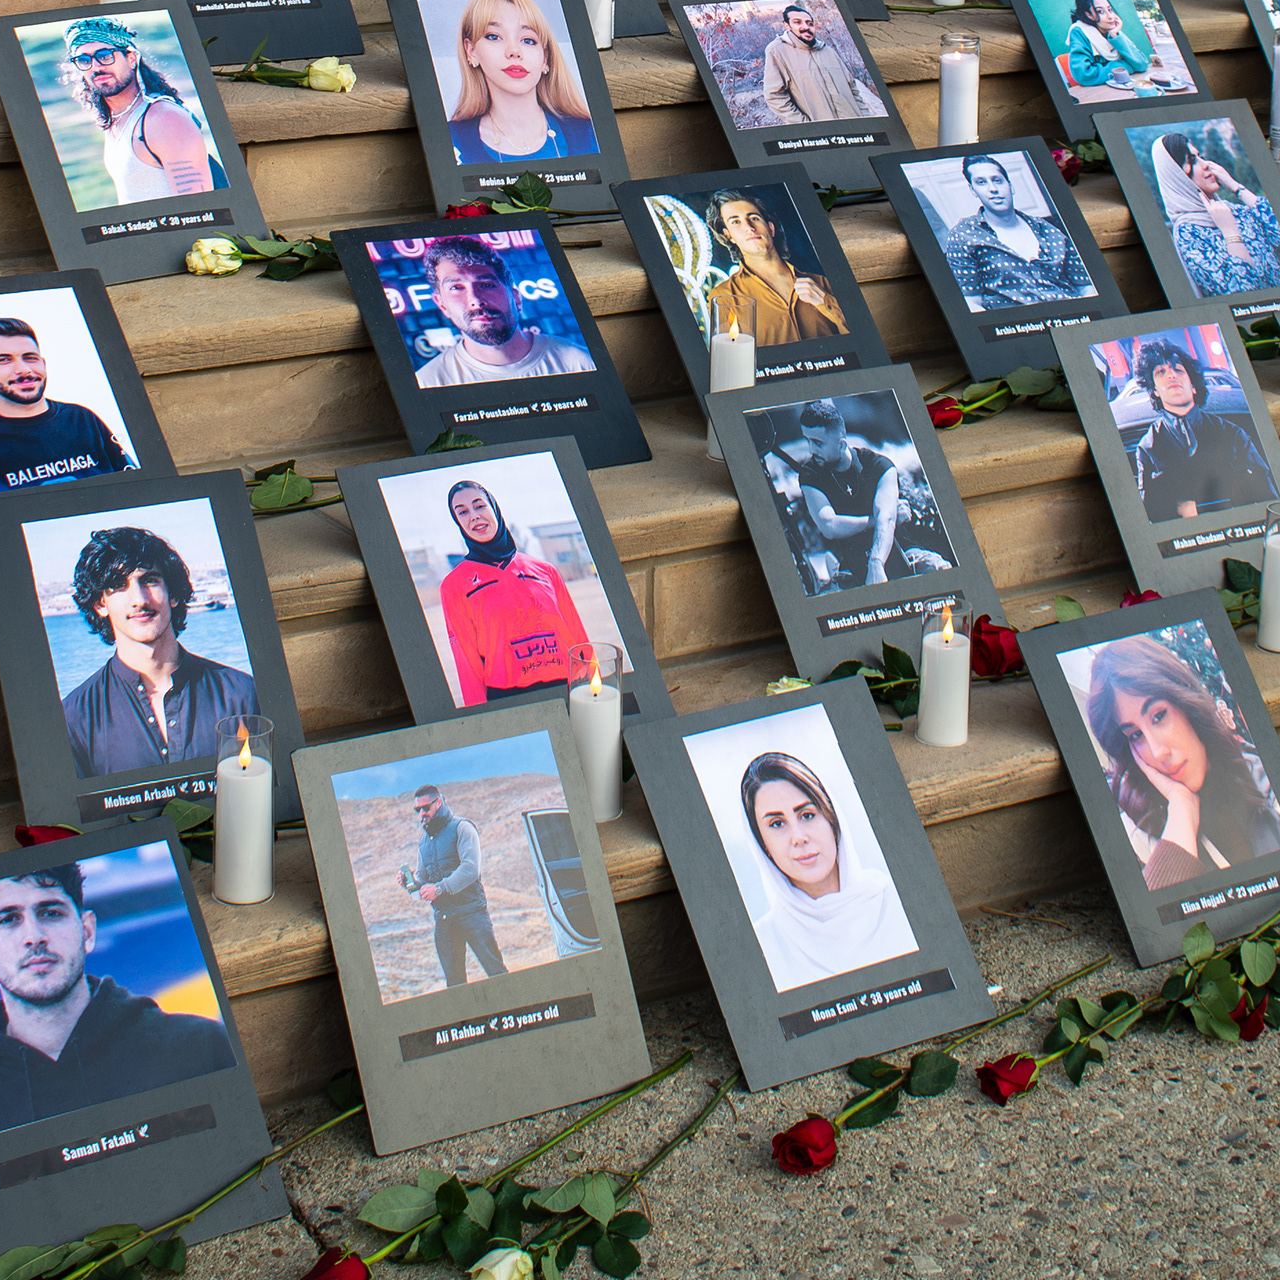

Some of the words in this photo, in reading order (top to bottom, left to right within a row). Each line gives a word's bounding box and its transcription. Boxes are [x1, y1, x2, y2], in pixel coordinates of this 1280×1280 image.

[453, 411, 479, 423] Farzin
[552, 400, 575, 413] years
[575, 397, 588, 408] old
[6, 453, 98, 488] BALENCIAGA
[104, 793, 142, 810] Mohsen
[143, 785, 177, 803] Arbabi
[192, 779, 207, 794] 20
[810, 1005, 837, 1023] Mona
[835, 998, 858, 1015] Esmi
[870, 991, 884, 1006] 38
[883, 986, 909, 1004] years
[907, 979, 923, 995] old
[435, 1030, 449, 1046] Ali
[451, 1024, 486, 1042] Rahbar
[501, 1015, 515, 1030] 33
[516, 1011, 543, 1029] years
[543, 1004, 559, 1021] old
[62, 1142, 101, 1162] Saman
[100, 1129, 136, 1151] Fatahi
